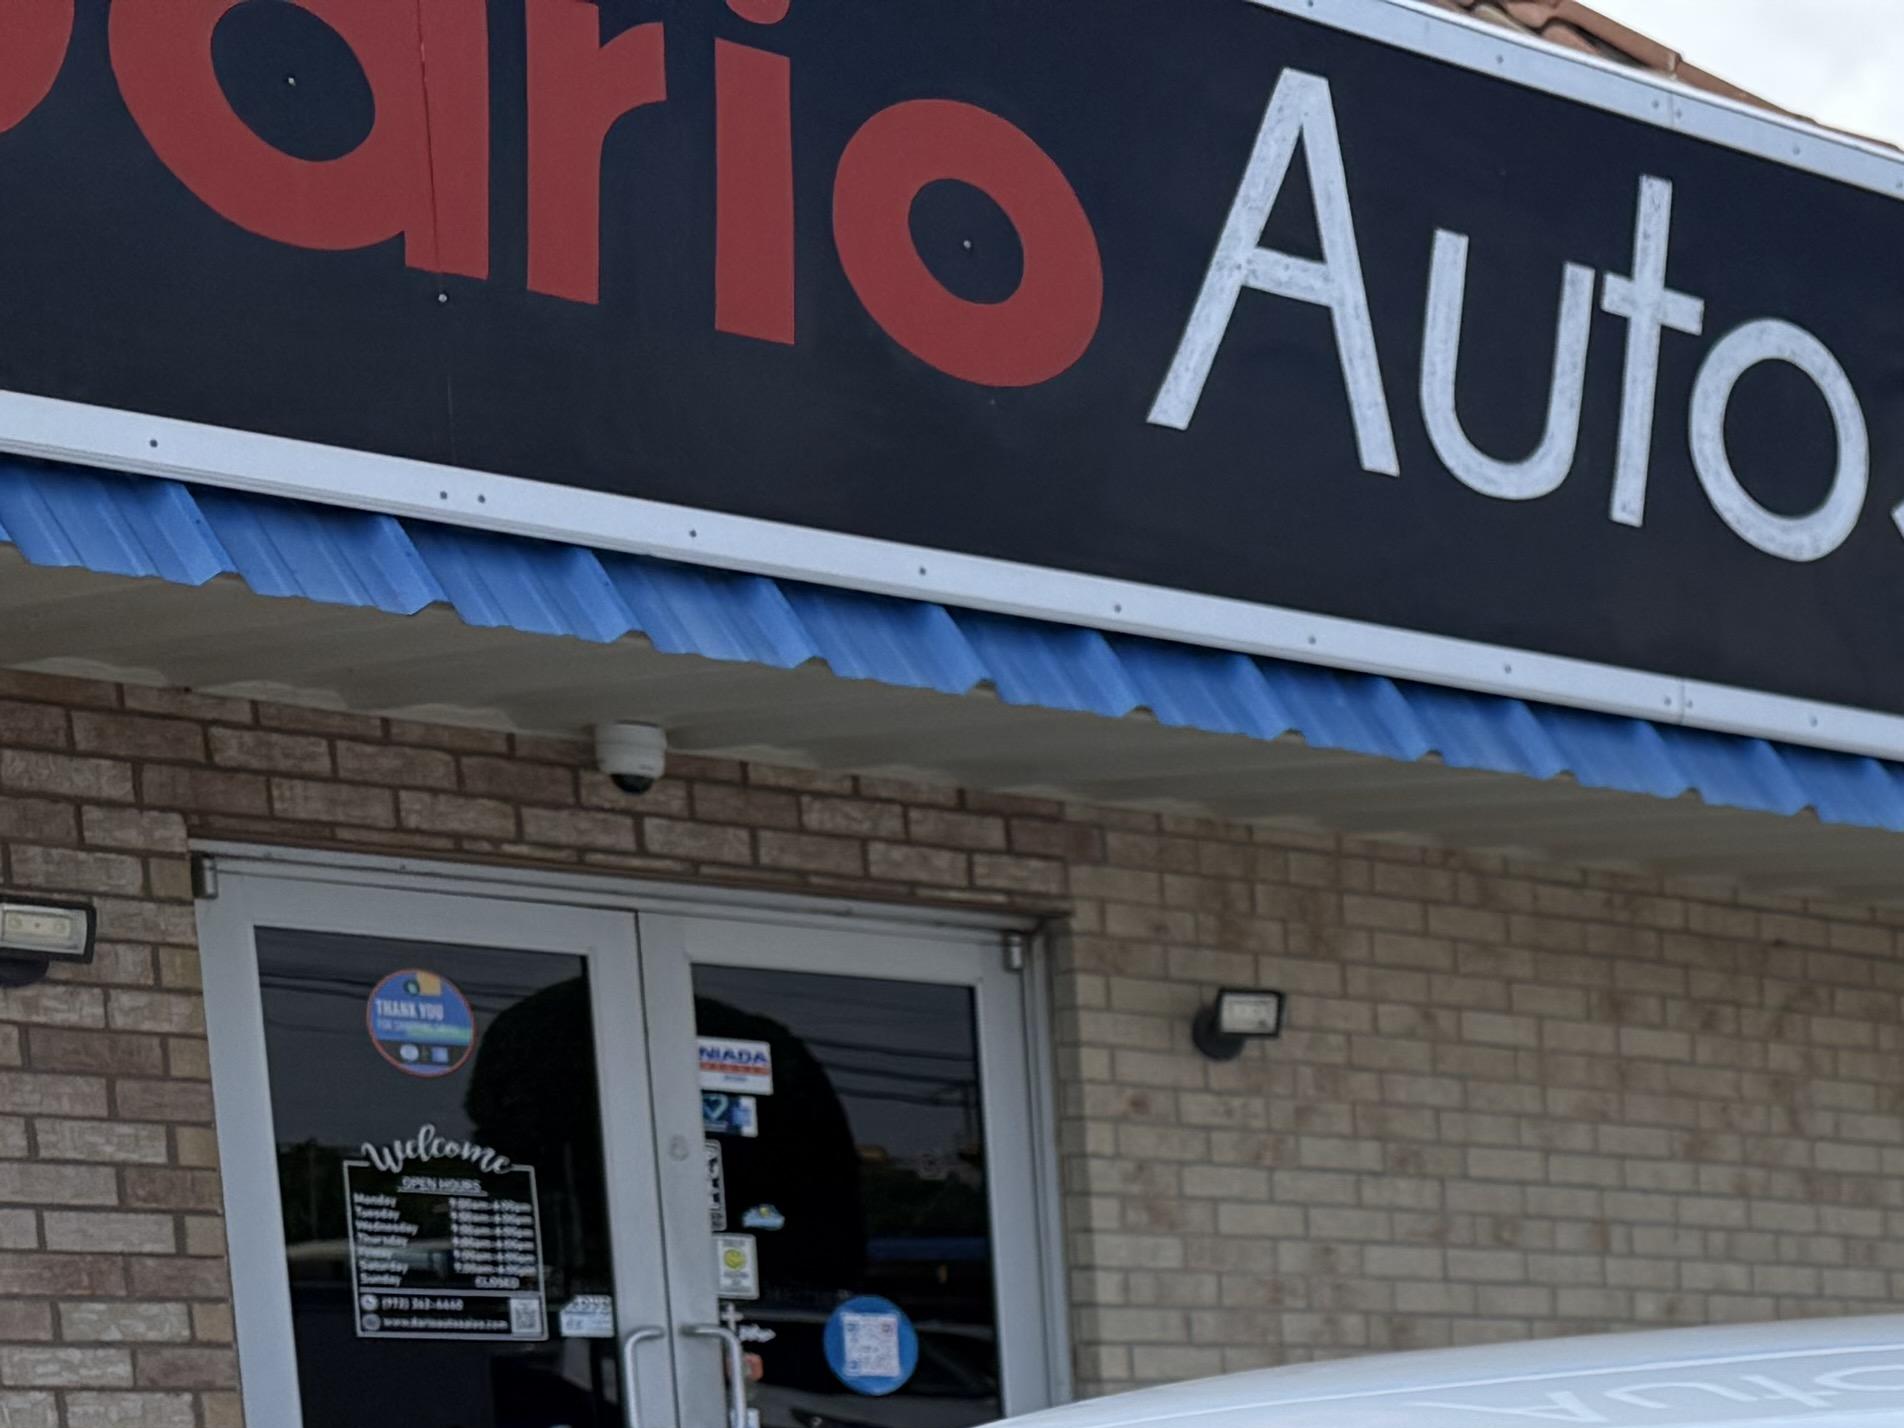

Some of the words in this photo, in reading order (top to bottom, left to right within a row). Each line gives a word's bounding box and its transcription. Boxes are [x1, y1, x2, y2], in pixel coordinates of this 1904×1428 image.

[0, 0, 1103, 386] ario
[1146, 65, 1871, 563] Auto
[375, 999, 418, 1019] THANK
[418, 1002, 445, 1021] YOU
[360, 1124, 511, 1174] Welcome
